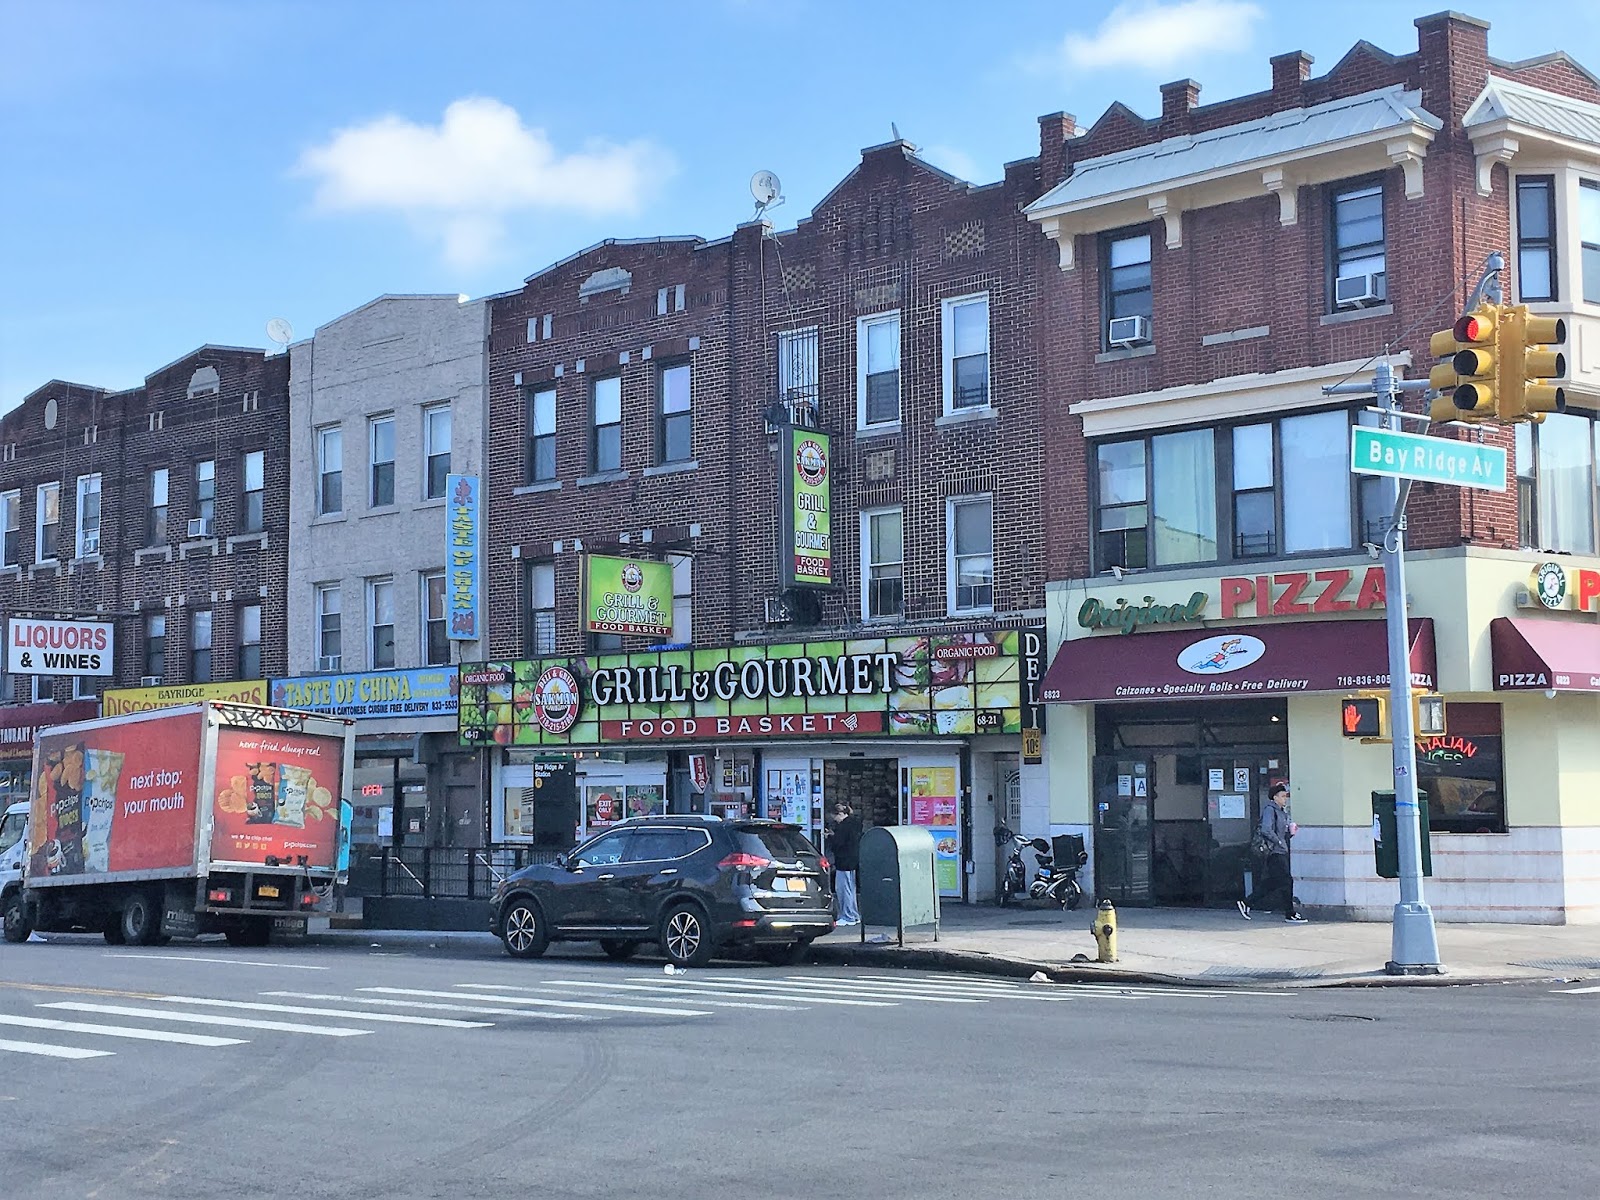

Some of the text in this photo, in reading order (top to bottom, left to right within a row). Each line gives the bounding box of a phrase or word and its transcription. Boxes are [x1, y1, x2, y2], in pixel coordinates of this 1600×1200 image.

[1369, 440, 1493, 478] Bay Ridge Av
[798, 492, 827, 512] GRILL
[807, 513, 817, 530] &
[795, 531, 830, 551] GOURMET
[452, 507, 474, 610] TASTE OF CHINA
[800, 556, 825, 567] FOOD
[796, 565, 829, 576] BASKET
[1538, 562, 1566, 587] ORIGINAL
[603, 592, 659, 611] GRILL &
[1078, 566, 1387, 634] Original PIZZA
[1541, 594, 1563, 607] PIZZA
[596, 606, 666, 625] GOURMET
[595, 622, 668, 634] FOOD BASKET
[15, 625, 107, 650] LIQUORS
[21, 652, 101, 670] & WINES
[937, 646, 996, 658] ORGANIC FOOD
[464, 673, 506, 683] ORGANIC FOOD
[539, 670, 551, 688] DELI
[559, 670, 575, 689] GRILL
[591, 666, 687, 706] GRILL
[714, 653, 898, 701] GOURMET
[1024, 633, 1040, 729] DELI
[1115, 678, 1309, 696] Calzones Specialty Rolls Free Delivery
[1499, 673, 1548, 686] PIZZA
[158, 688, 205, 700] BAYRIDGE
[285, 681, 332, 708] TASTE
[335, 679, 356, 704] OF
[359, 675, 413, 703] CHINA
[535, 692, 578, 705] SAKMAN
[1043, 690, 1060, 699] 6823
[390, 703, 403, 713] FREE
[404, 702, 429, 713] DELIVERY
[431, 700, 458, 710] 833-5533
[621, 714, 837, 736] FOOD BASKET
[977, 715, 997, 725] 68-21
[239, 740, 258, 749] never
[281, 744, 304, 757] always
[534, 770, 551, 778] Station
[544, 763, 558, 771] Ridge
[697, 757, 706, 779] ATM
[131, 769, 183, 789] next stop:
[1137, 779, 1146, 792] A
[362, 785, 383, 797] OPEN
[123, 791, 185, 818] your mouth
